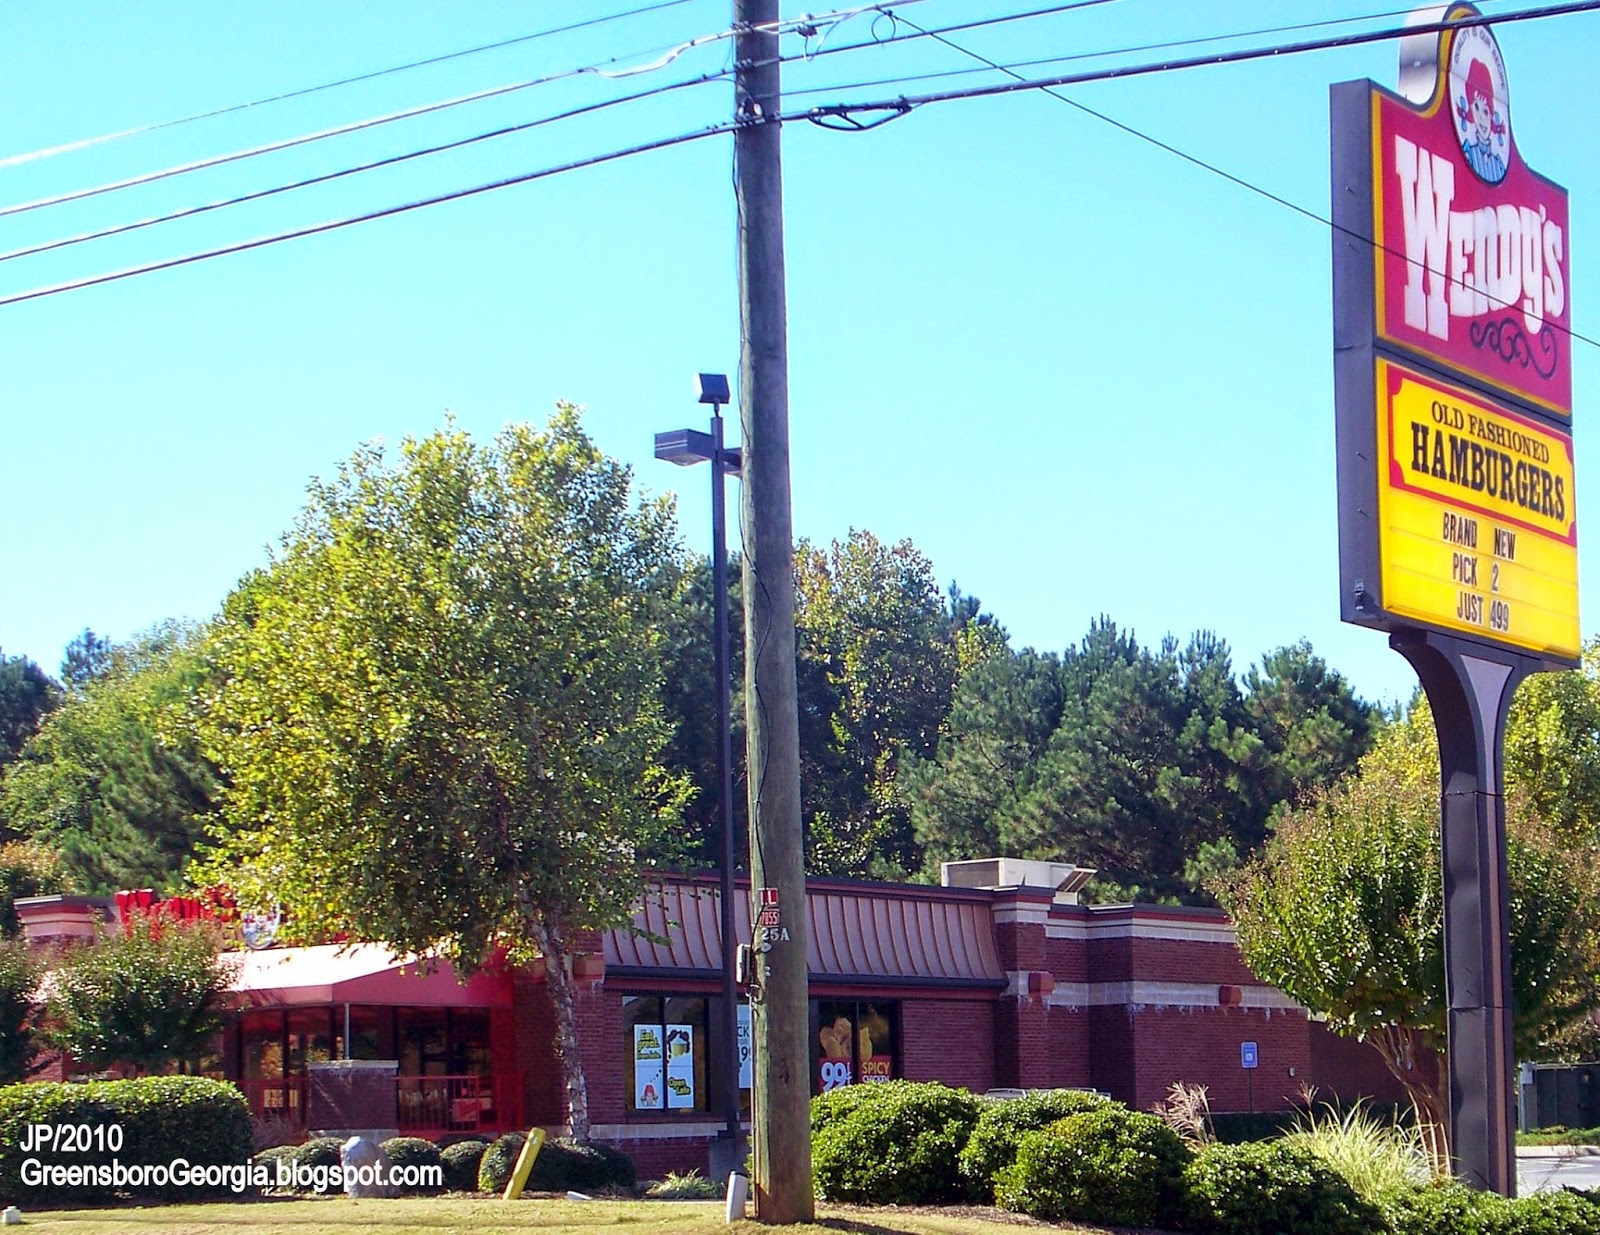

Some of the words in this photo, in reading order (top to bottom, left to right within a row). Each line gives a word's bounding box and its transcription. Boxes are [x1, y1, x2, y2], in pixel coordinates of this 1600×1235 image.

[1432, 401, 1464, 430] OLD
[1468, 413, 1549, 464] FASHIONED
[1411, 421, 1566, 523] HAMBURGERS
[1443, 512, 1477, 549] BRAND
[1494, 527, 1516, 560] NEW
[1453, 552, 1477, 586] PICK
[1492, 563, 1499, 592] 2
[1457, 591, 1483, 624] JUST
[1490, 600, 1509, 632] 499
[761, 927, 790, 941] 25A
[862, 1061, 890, 1075] SPICY
